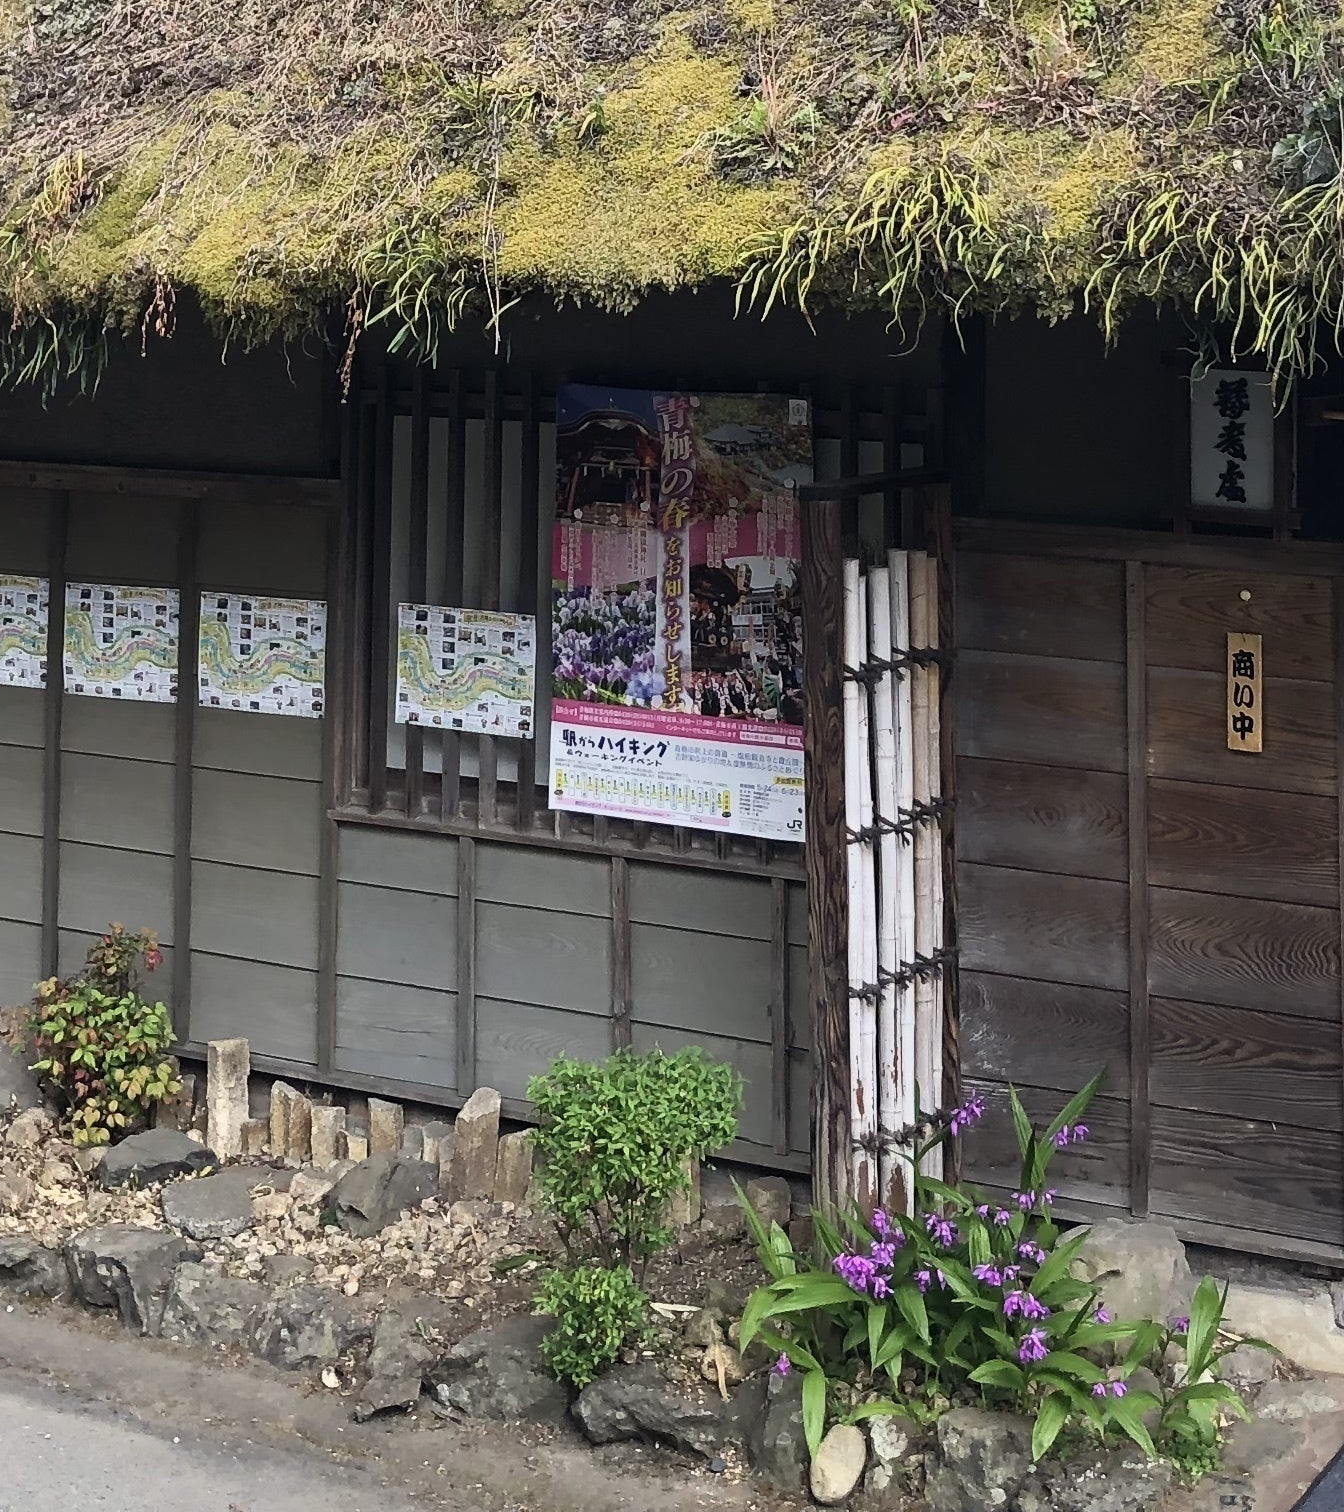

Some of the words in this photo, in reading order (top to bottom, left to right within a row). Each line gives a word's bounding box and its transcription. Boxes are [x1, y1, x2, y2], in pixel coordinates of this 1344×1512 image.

[1232, 649, 1256, 741] 商い中
[562, 729, 671, 758] 駅からハイキング
[786, 819, 803, 830] JR
